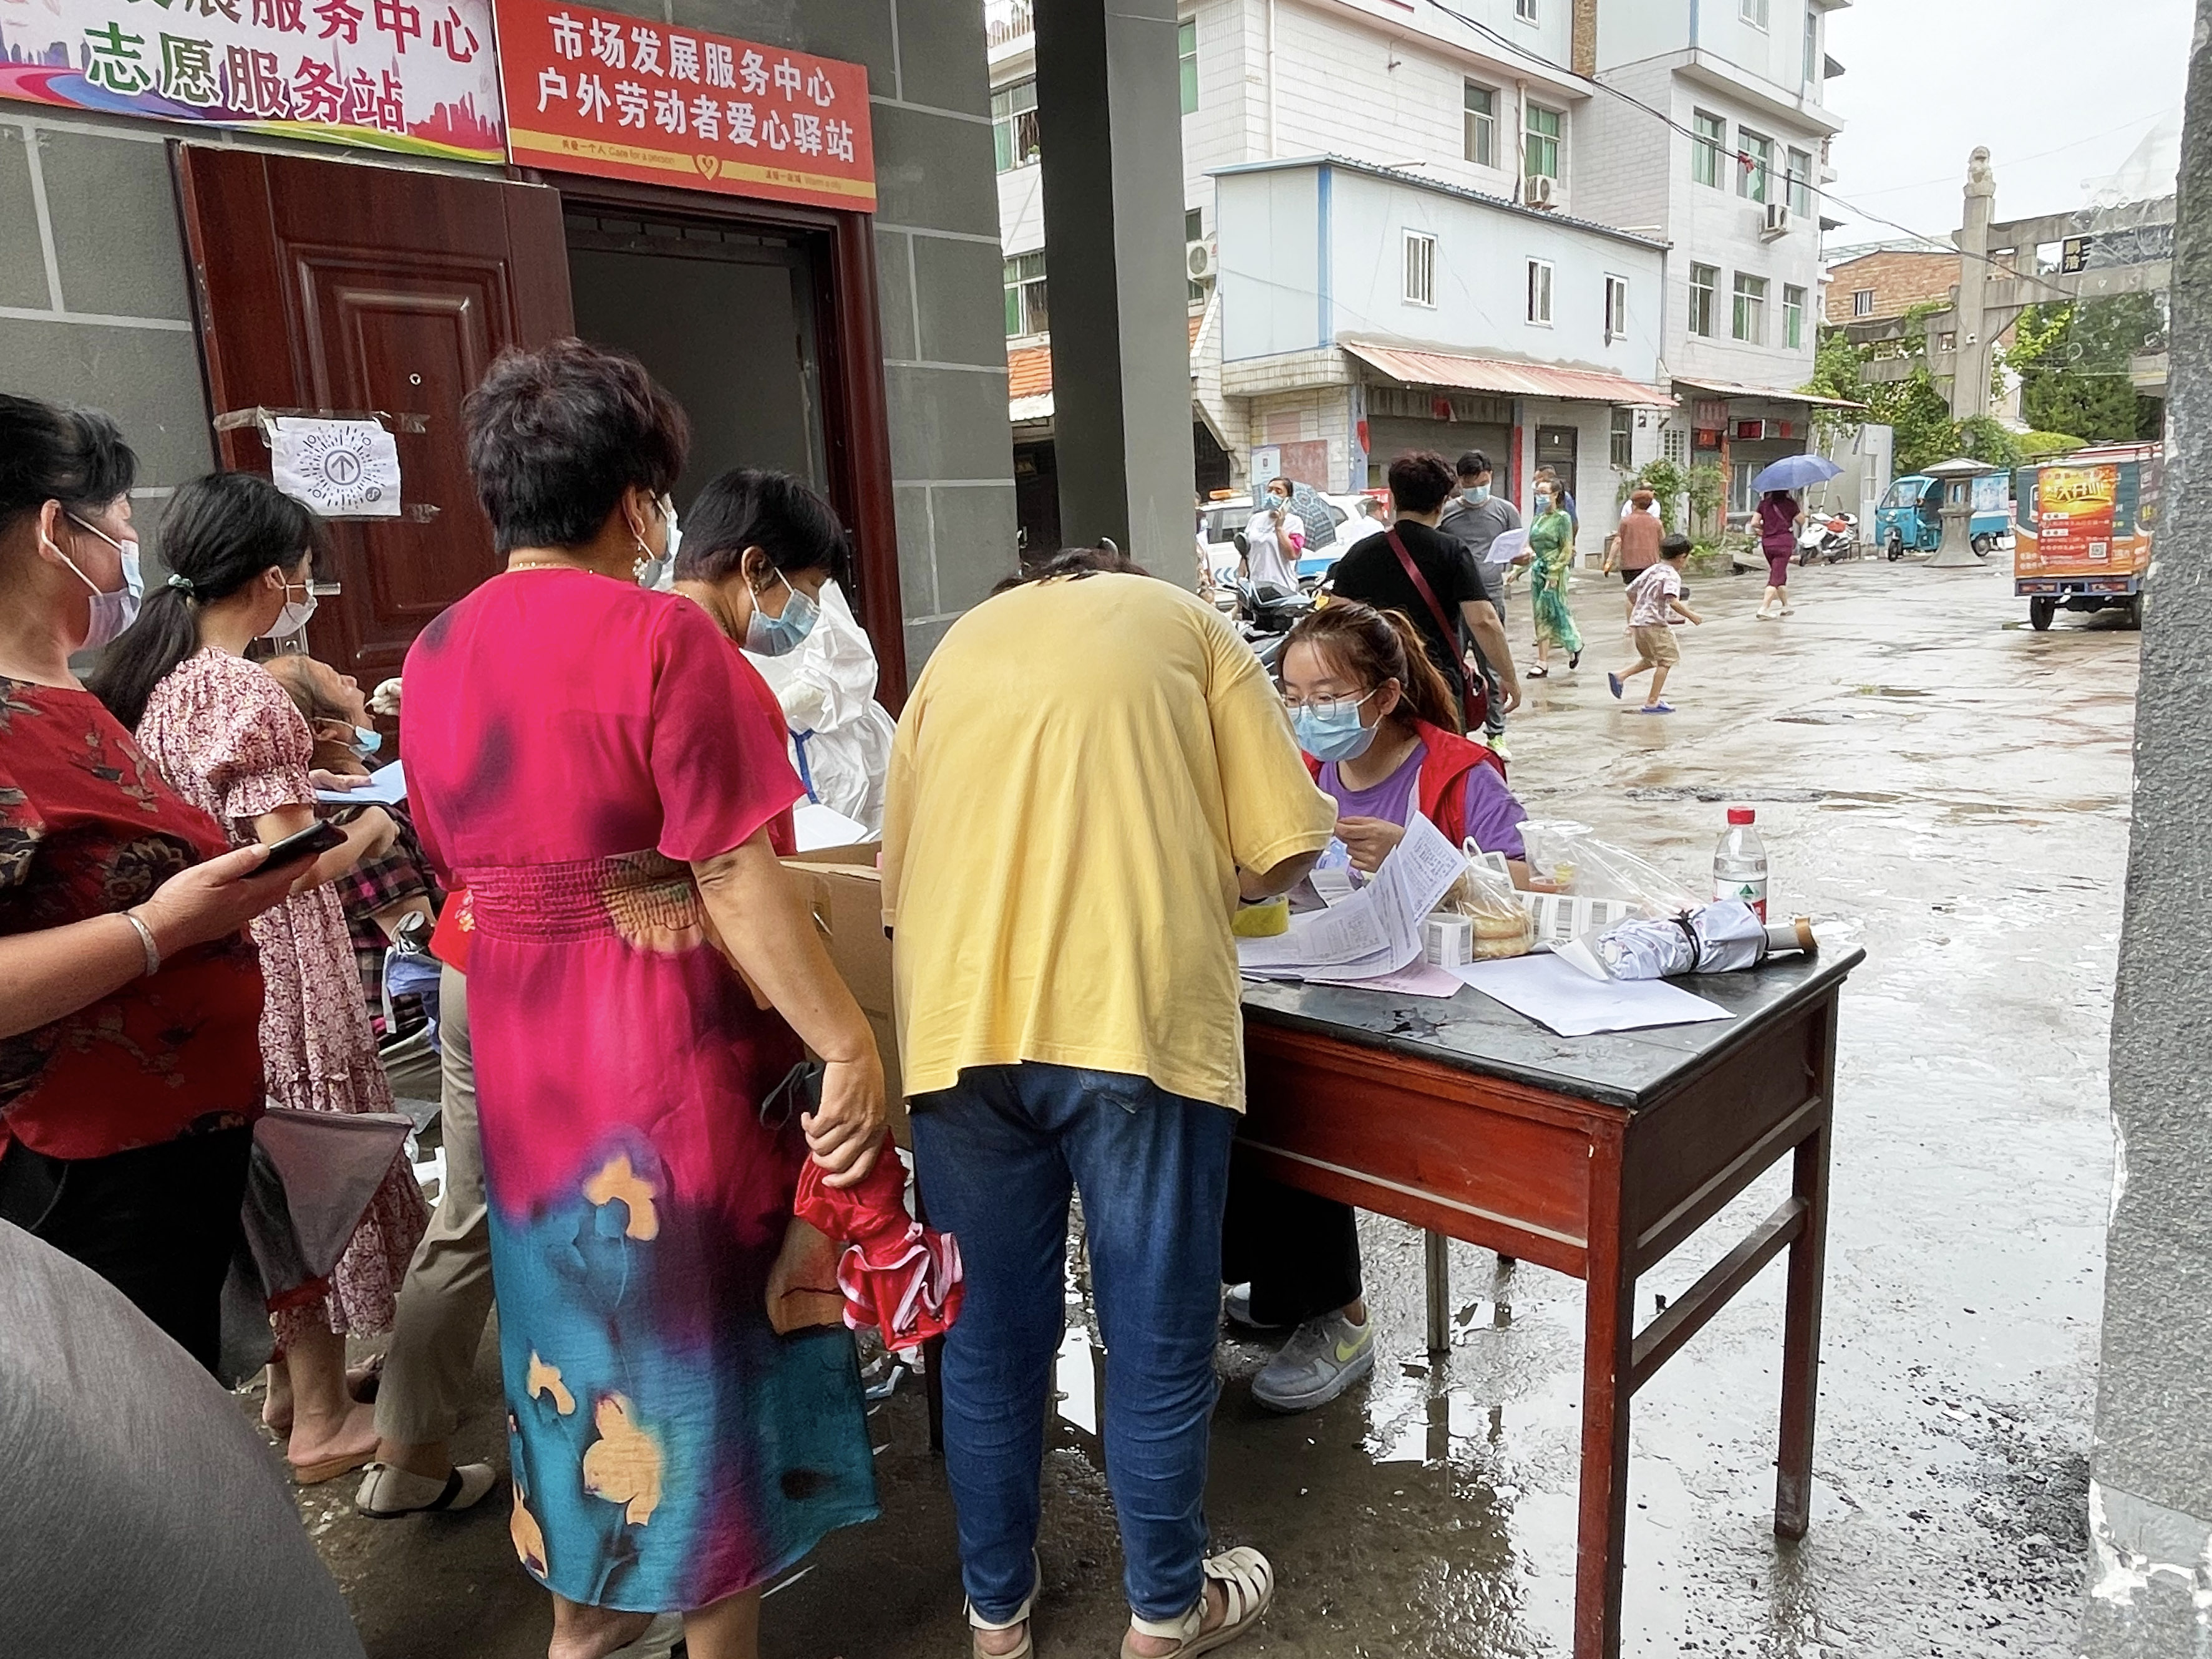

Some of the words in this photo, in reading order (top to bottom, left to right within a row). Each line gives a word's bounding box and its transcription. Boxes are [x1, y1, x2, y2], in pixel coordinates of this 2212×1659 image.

[85, 22, 408, 133] 志愿服务站
[125, 0, 479, 64] 服务中心
[548, 12, 836, 107] 市场发展服务中心
[536, 66, 855, 163] 户外劳动者爱心驿站
